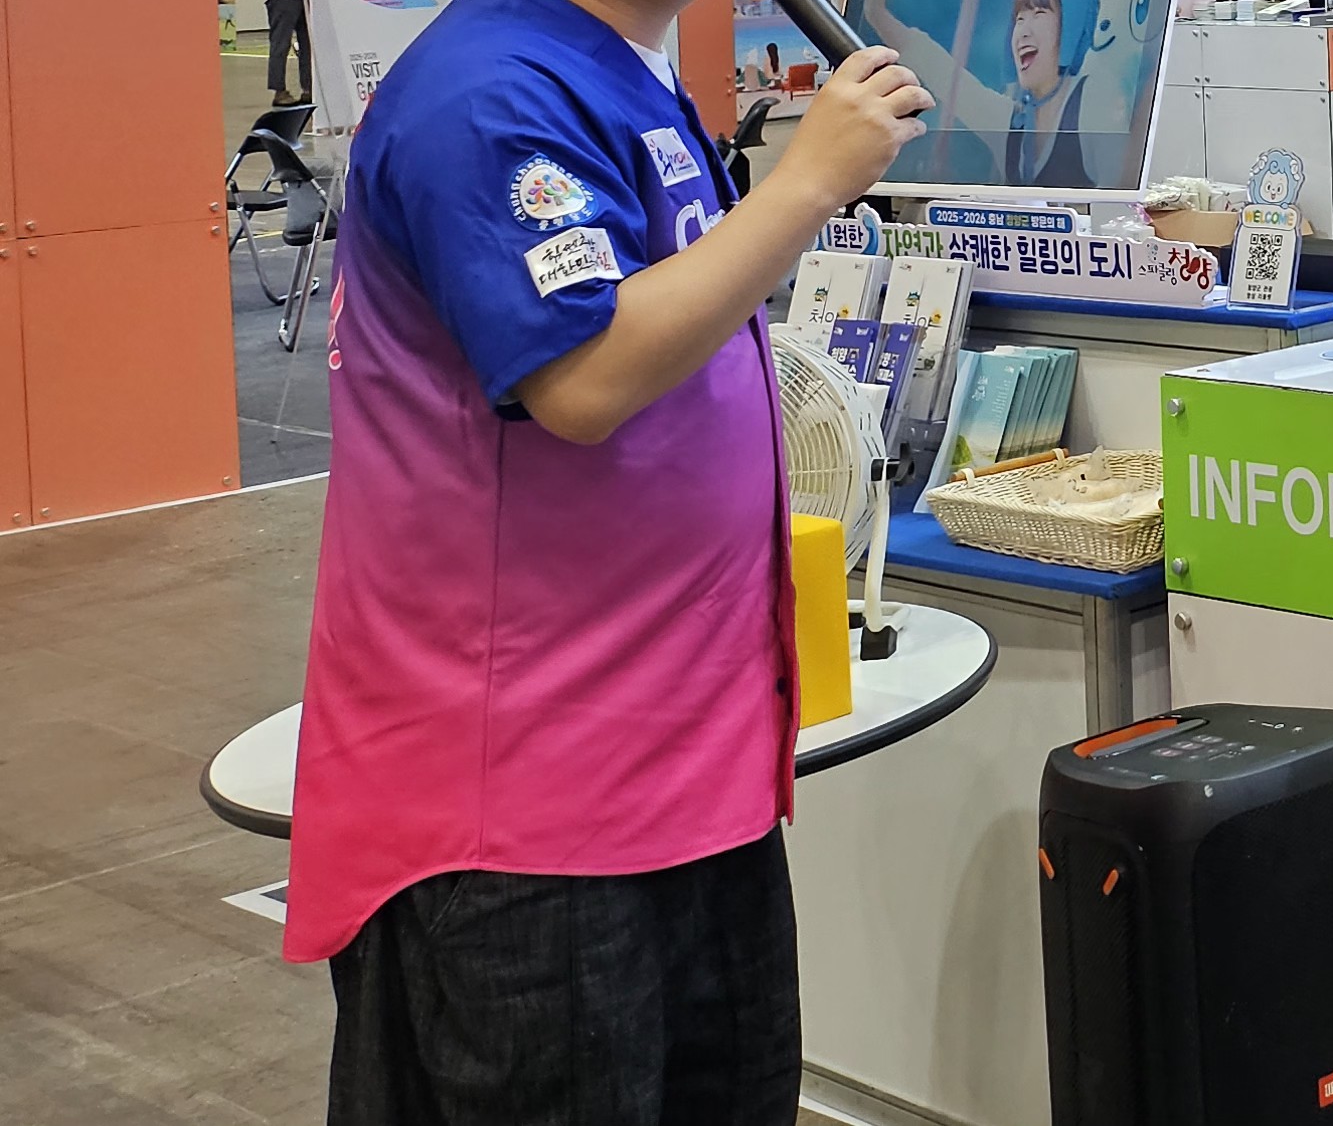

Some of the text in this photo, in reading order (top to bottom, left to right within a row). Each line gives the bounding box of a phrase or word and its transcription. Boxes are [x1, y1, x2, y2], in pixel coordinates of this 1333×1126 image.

[351, 61, 381, 79] VISIT
[936, 209, 987, 224] 2025-2026
[988, 212, 1005, 226] 충남
[1030, 215, 1055, 229] 방문의
[1244, 209, 1295, 227] WELCOME
[881, 227, 944, 260] 자연과
[948, 232, 1012, 272] 상쾌한
[1016, 235, 1082, 276] 힐링의
[1089, 241, 1133, 280] 도시
[1137, 247, 1213, 290] 스파클링 청양
